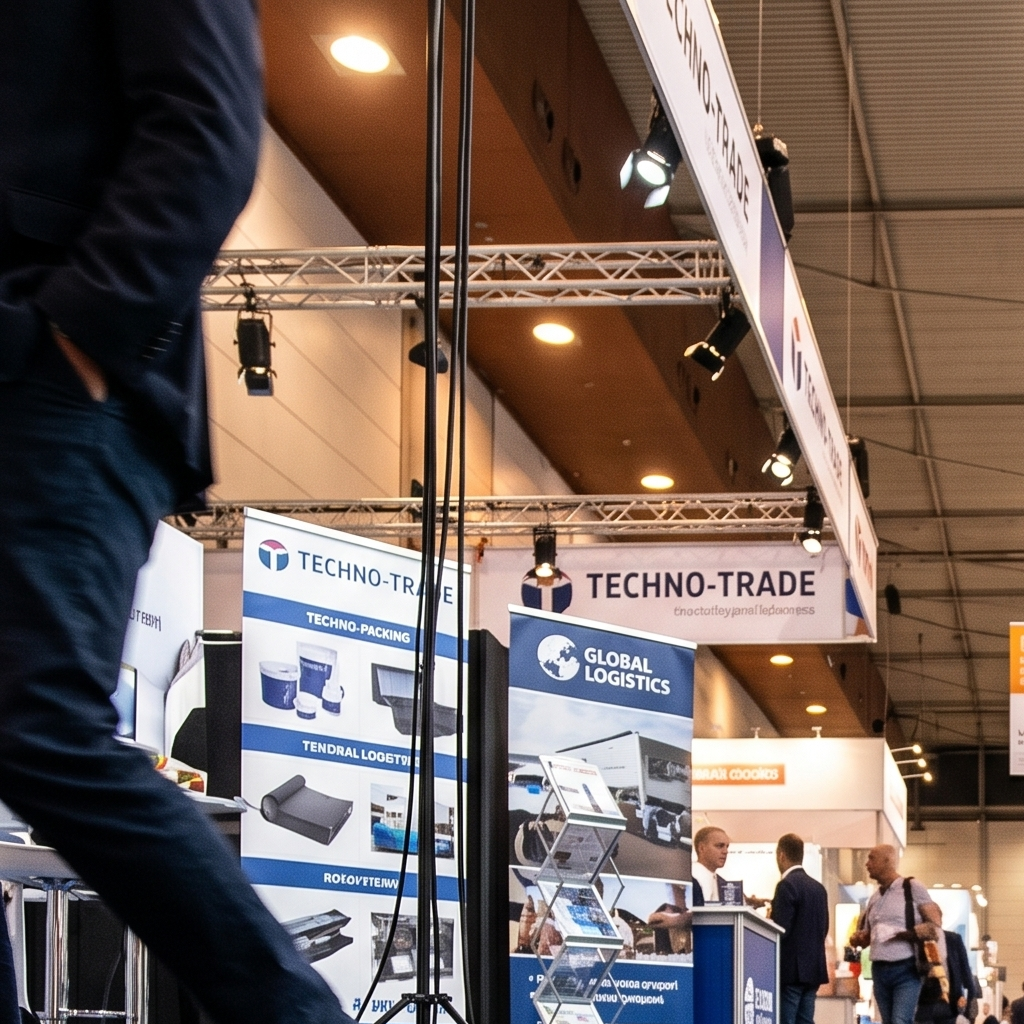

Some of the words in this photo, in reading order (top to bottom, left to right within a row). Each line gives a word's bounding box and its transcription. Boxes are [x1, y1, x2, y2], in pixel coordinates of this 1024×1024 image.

[298, 550, 453, 605] TECHNO-TRE
[586, 570, 816, 599] TECHNO-TRADE
[306, 612, 411, 643] TECHNO-PACKING
[584, 647, 653, 674] GLOBAL
[584, 665, 671, 695] LOGISTICS
[302, 740, 360, 759] TENDRAL
